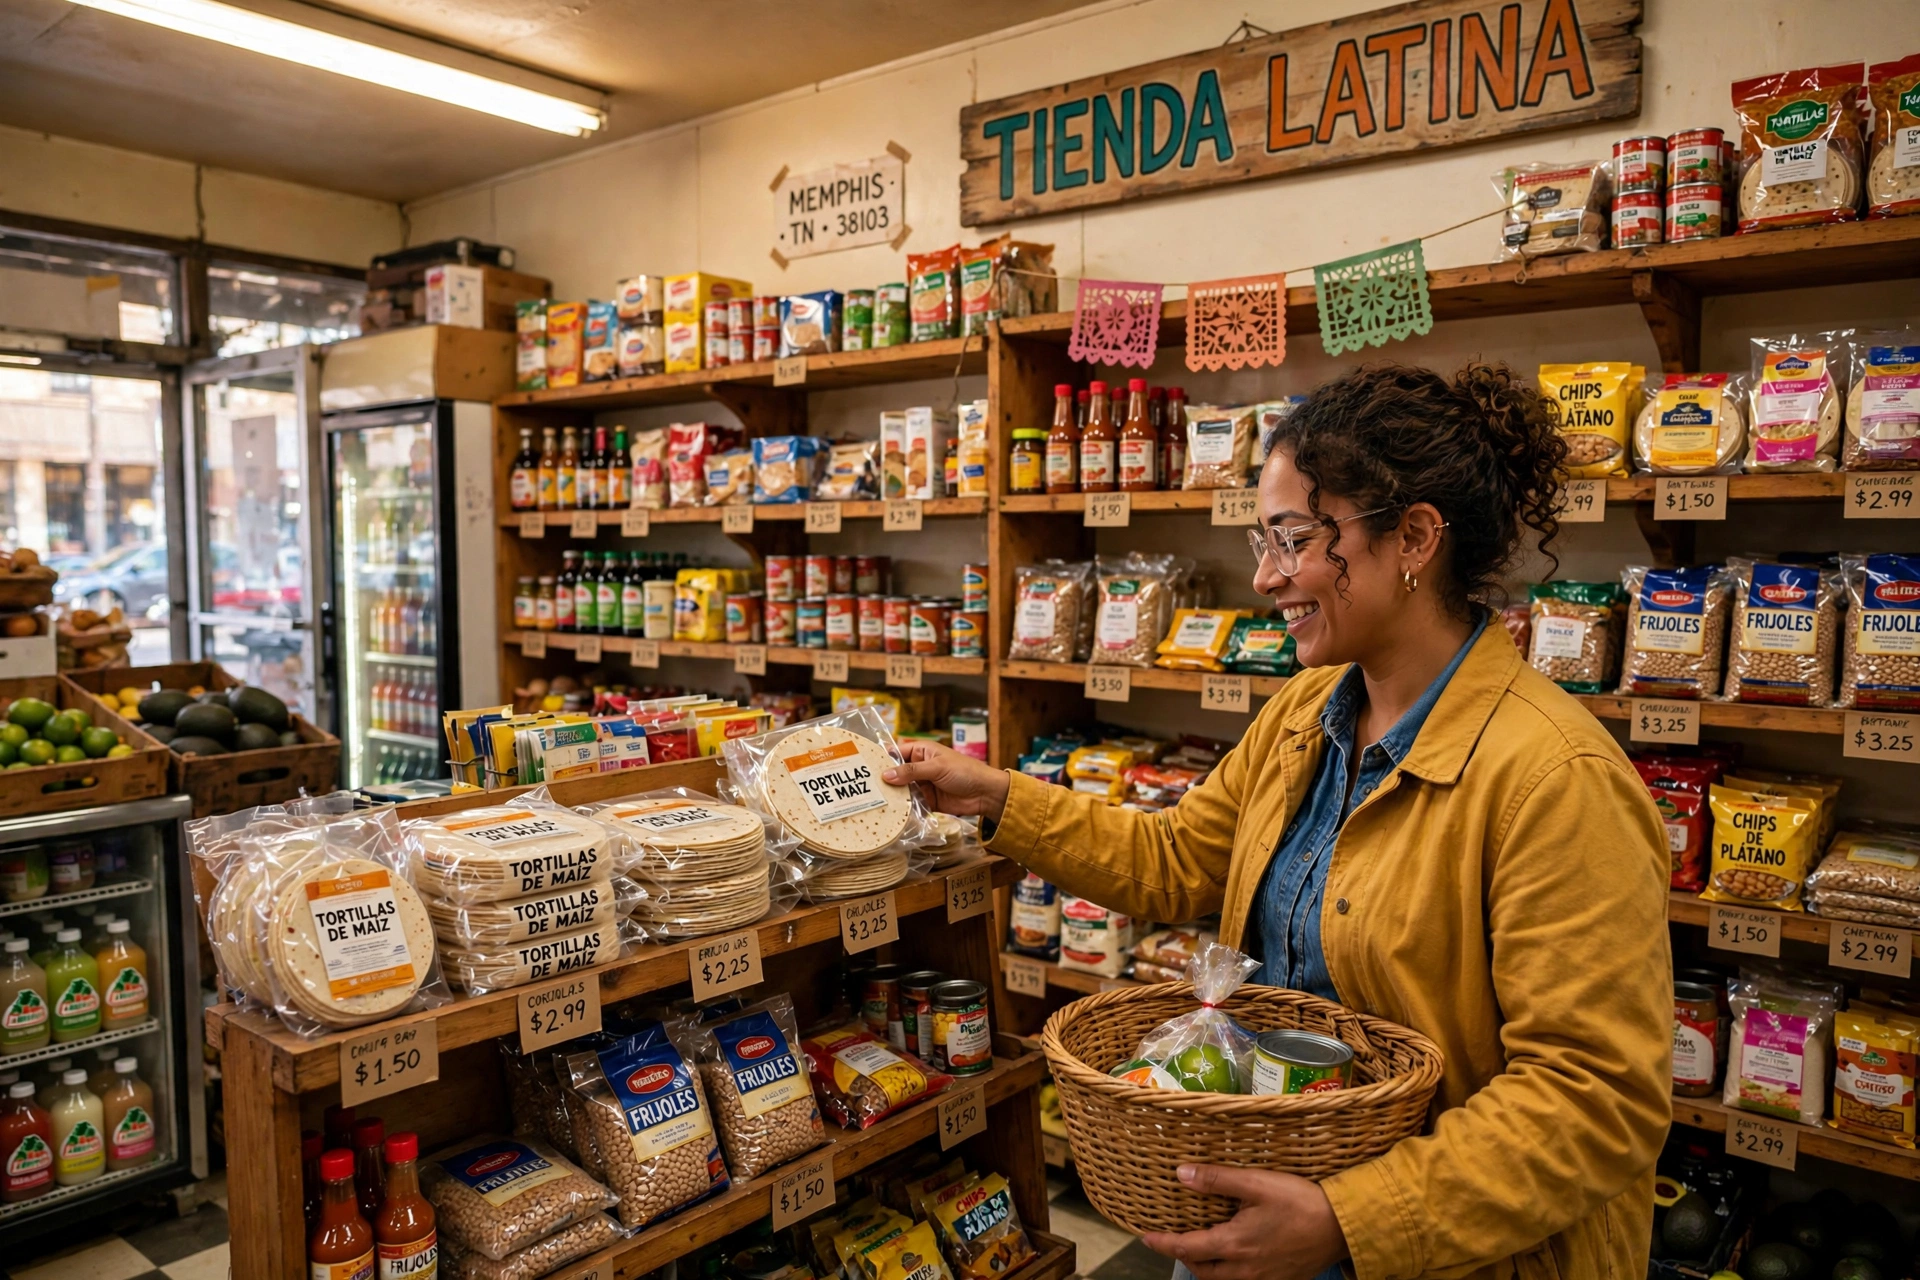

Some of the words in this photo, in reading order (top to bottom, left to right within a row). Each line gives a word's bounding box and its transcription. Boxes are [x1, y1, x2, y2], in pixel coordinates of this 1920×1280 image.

[983, 68, 1235, 202] TIENDA
[1265, 0, 1595, 153] LATINA
[790, 172, 884, 215] MEMPHIS
[790, 219, 814, 245] TN
[837, 205, 889, 237] 38103
[1559, 382, 1603, 401] CHIPS
[1573, 401, 1587, 410] DE
[1219, 501, 1257, 518] $1.99
[1665, 492, 1715, 512] $1.50
[1855, 489, 1913, 510] $2.99
[1639, 614, 1701, 635] FRIJOLES
[1746, 612, 1814, 633] FRIJOLES
[1207, 687, 1243, 704] $3.99
[1640, 715, 1686, 735] $3.25
[1854, 729, 1914, 752] $3.25
[798, 764, 872, 794] TORTILLAS
[813, 790, 834, 807] DE
[834, 779, 872, 801] MAÍZ
[631, 806, 709, 825] TORTILLAS
[1732, 811, 1777, 833] CHIPS
[464, 820, 556, 839] TORTILLAS
[485, 832, 508, 842] DE
[1746, 830, 1764, 846] DE
[509, 847, 598, 878] TORTILLAS
[1721, 841, 1786, 867] PLÁTANO
[521, 875, 544, 892] DE
[550, 865, 592, 887] MAÍZ
[514, 889, 599, 922] TORTILLAS
[952, 886, 986, 911] $3.25
[315, 900, 396, 928] TORTILLAS
[528, 918, 549, 936] DE
[555, 907, 595, 929] MAÍZ
[848, 912, 889, 942] $3.25
[327, 925, 349, 943] DE
[352, 916, 391, 938] MAÍZ
[1718, 920, 1768, 944] $1.50
[519, 932, 601, 966] TORTILLAS
[1840, 938, 1898, 964] $2.99
[530, 962, 552, 980] DE
[557, 950, 597, 973] MAÍZ
[702, 953, 751, 985] $2.25
[530, 999, 586, 1035] $2.99
[355, 1048, 421, 1087] $1.50
[736, 1055, 796, 1092] FRIJOLES
[629, 1089, 697, 1132] FRIJOLES
[945, 1105, 977, 1135] $1.50
[1735, 1130, 1784, 1156] $2.99
[780, 1177, 824, 1213] $1.50
